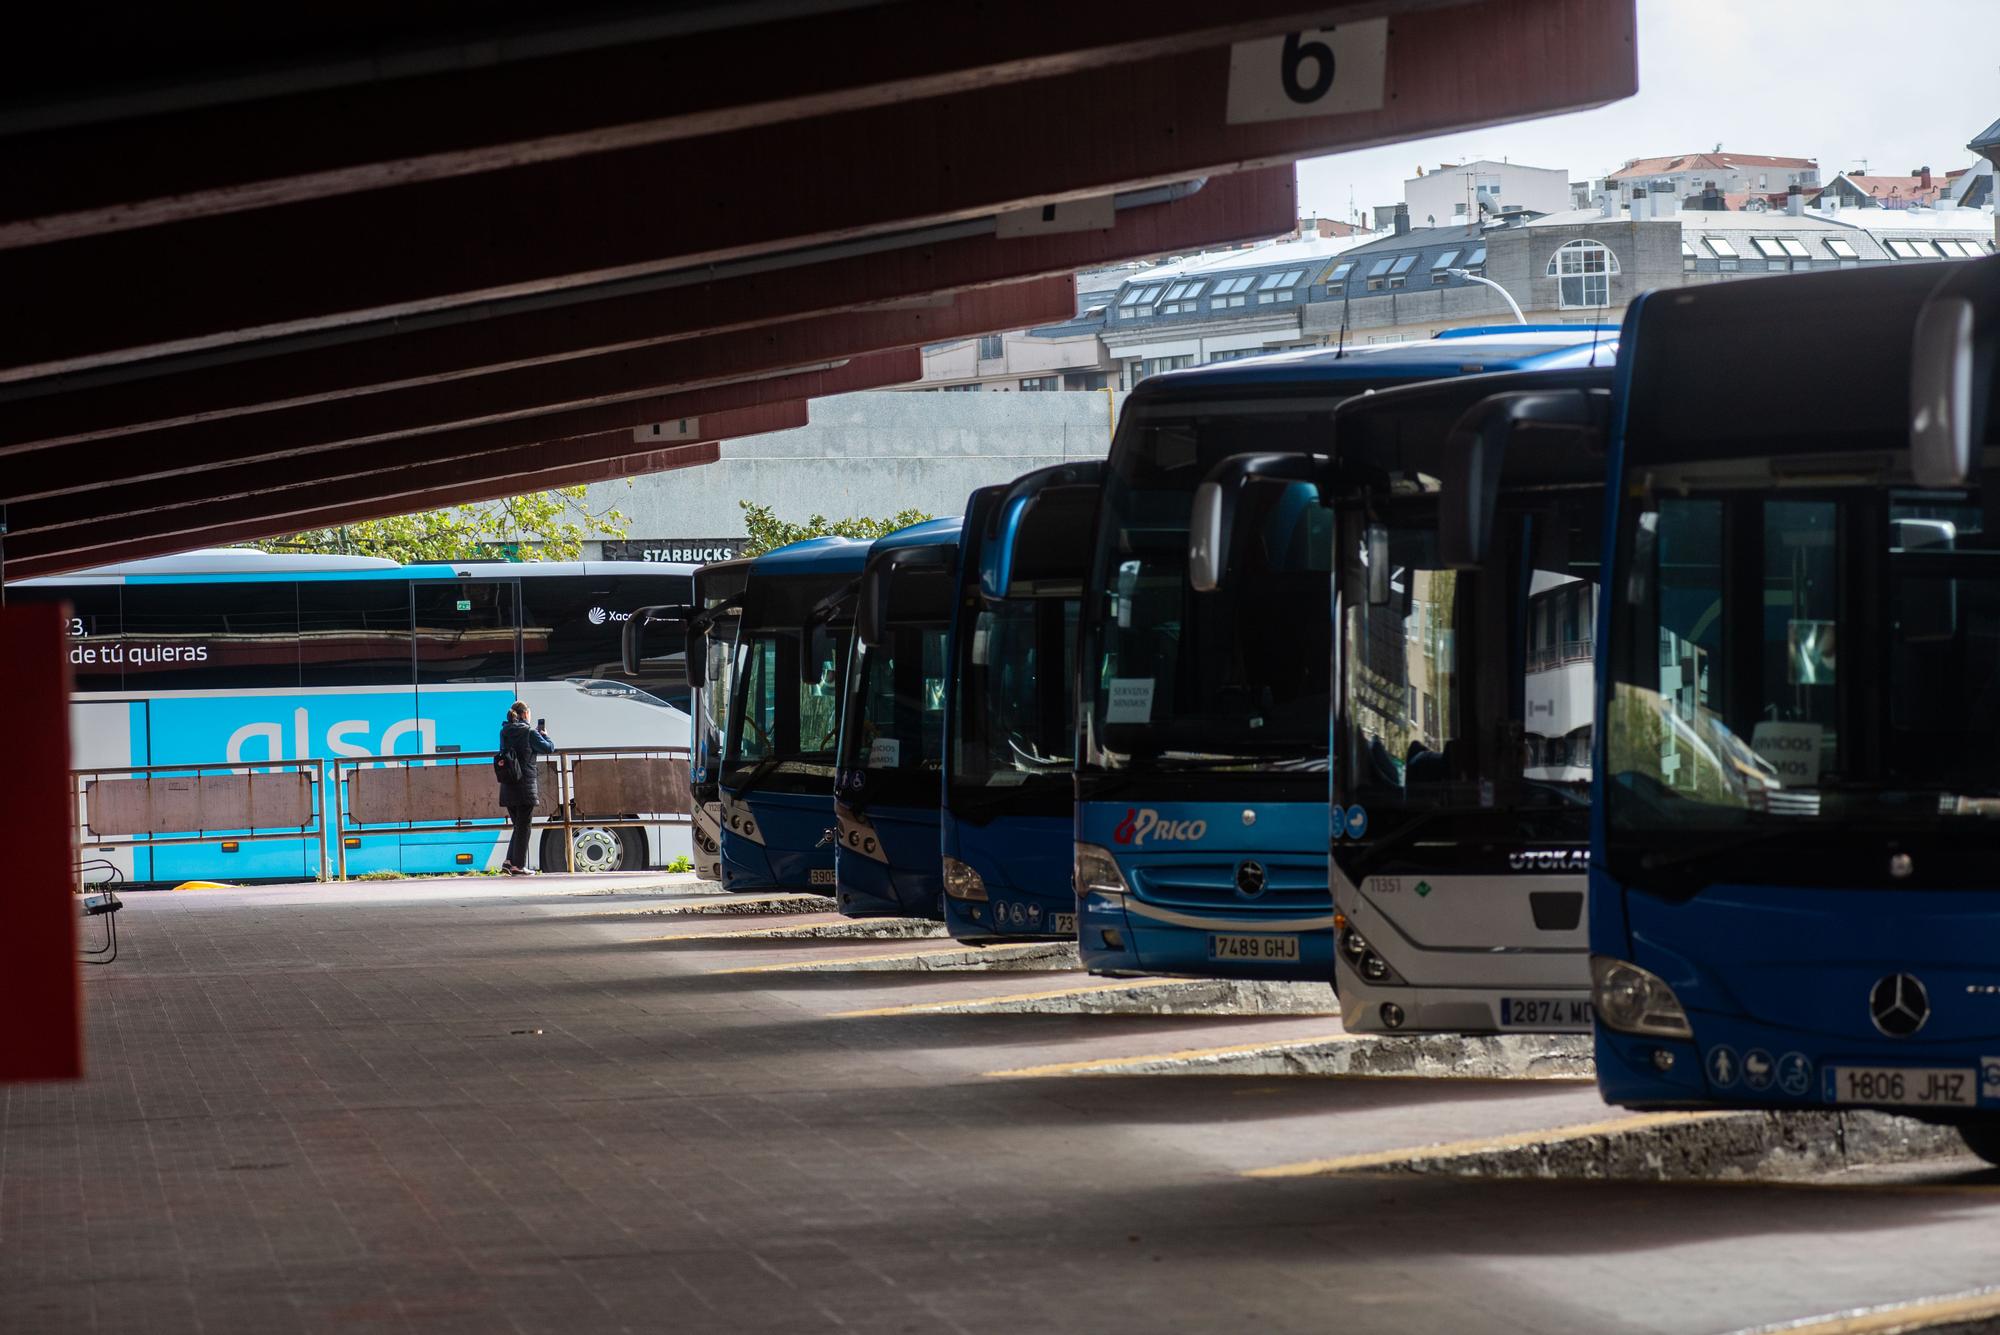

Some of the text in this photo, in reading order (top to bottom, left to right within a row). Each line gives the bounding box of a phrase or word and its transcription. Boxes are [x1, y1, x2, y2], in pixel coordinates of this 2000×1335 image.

[1281, 30, 1335, 104] 6
[643, 548, 732, 562] STARBUCKS
[66, 644, 208, 666] de tú quieras
[226, 706, 437, 781] alsa
[1370, 878, 1401, 893] 11351
[1058, 915, 1078, 931] 73
[1218, 937, 1296, 958] 7489 GHJ
[1513, 1001, 1563, 1023] 2874
[1847, 1072, 1905, 1100] 1806
[1917, 1073, 1966, 1103] JHZ
